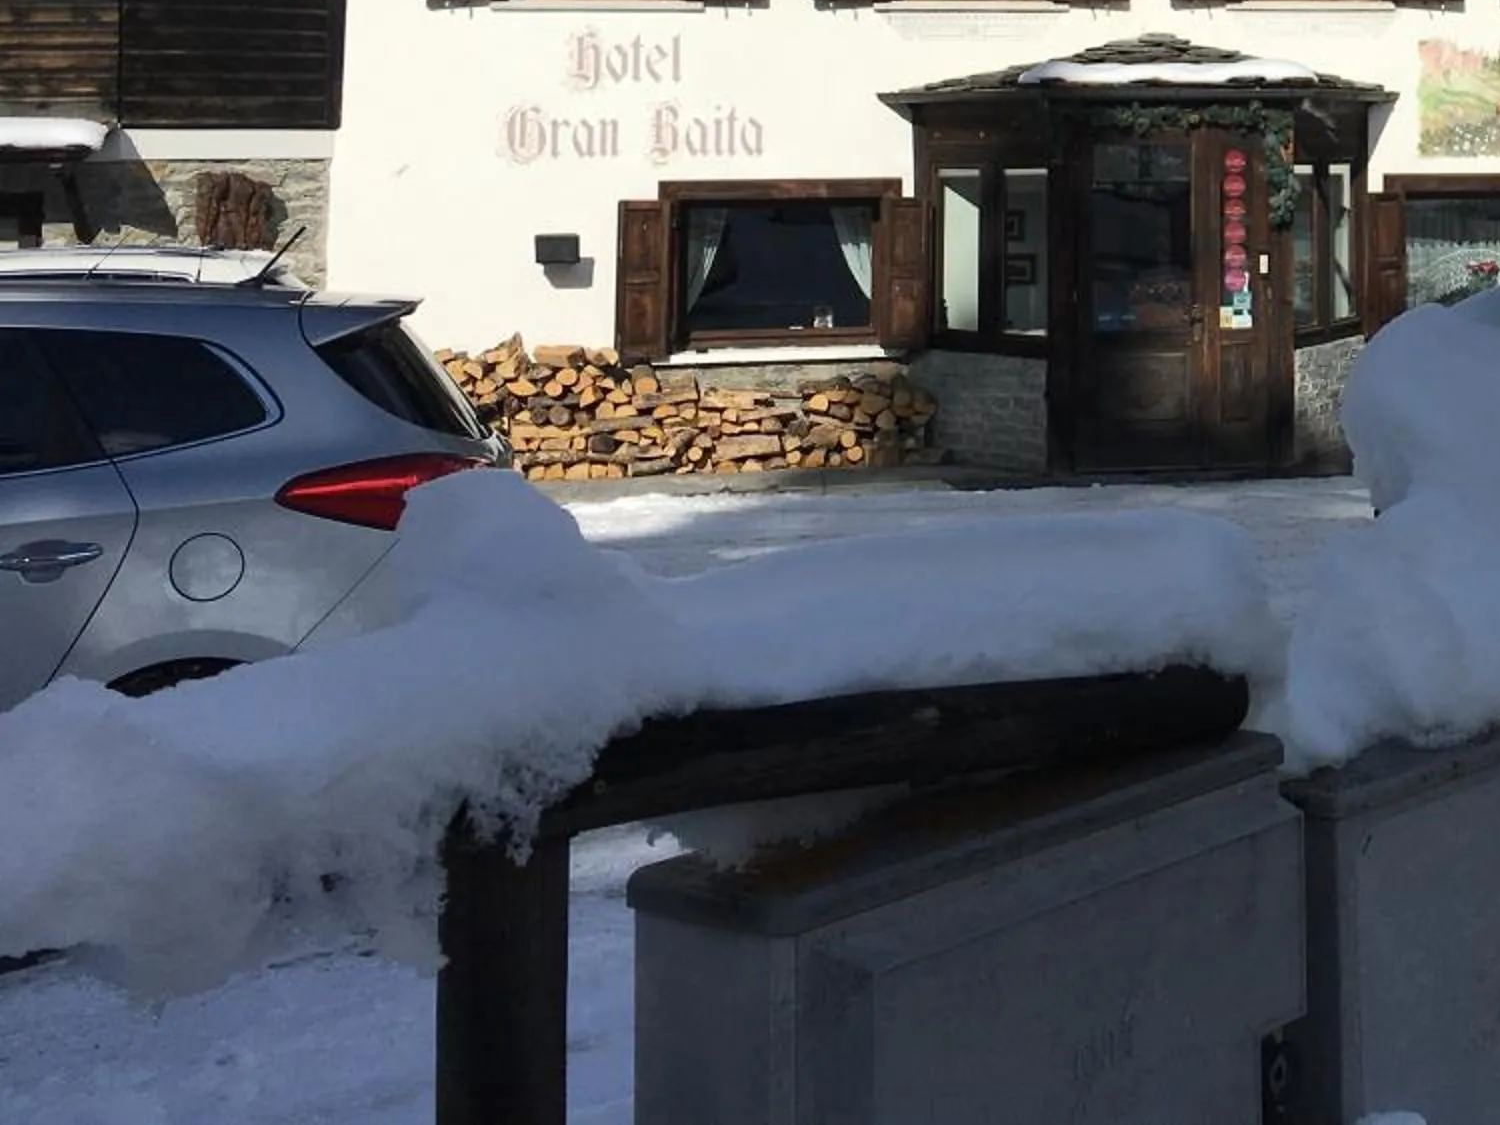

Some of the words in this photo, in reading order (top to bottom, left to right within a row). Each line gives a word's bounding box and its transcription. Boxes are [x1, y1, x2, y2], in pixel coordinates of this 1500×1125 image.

[567, 27, 683, 91] Hotel
[500, 104, 621, 166] Gran
[645, 101, 765, 166] Baita
